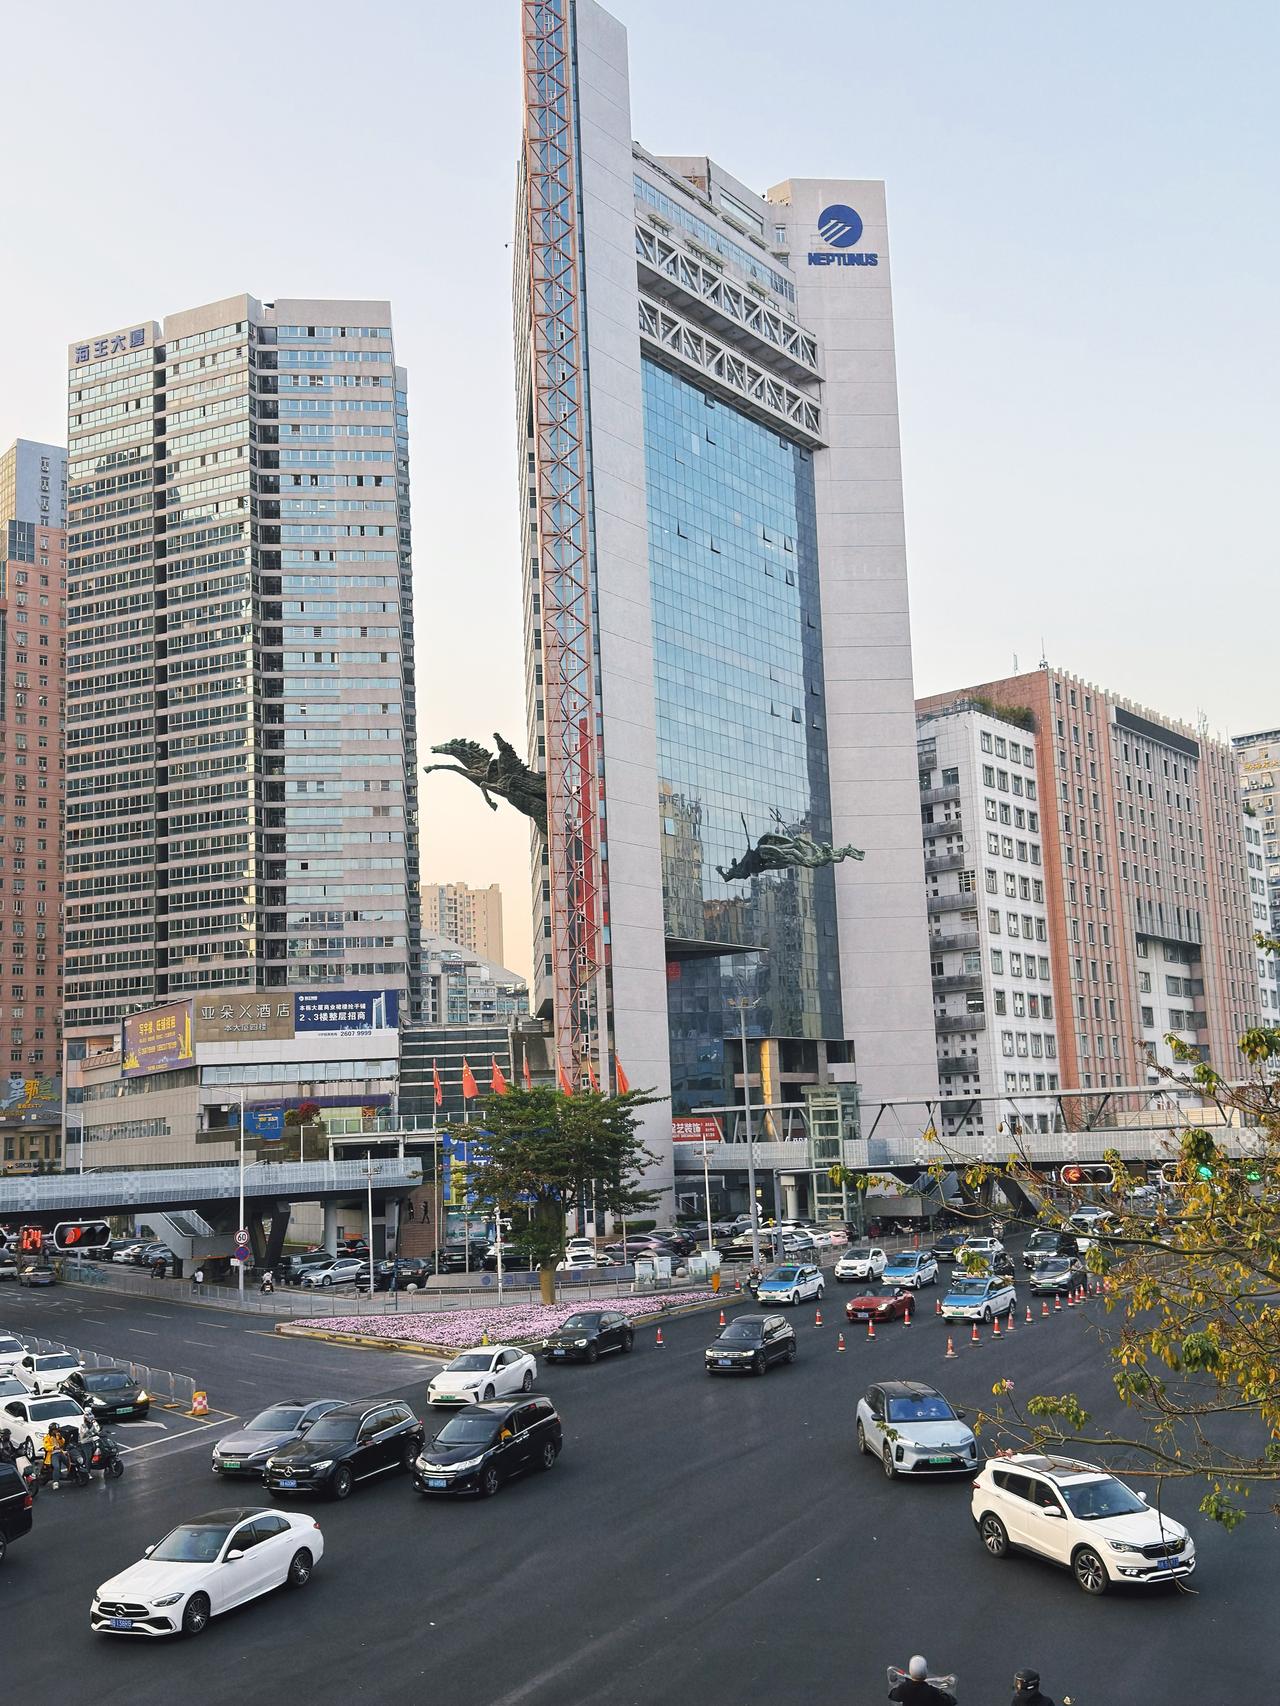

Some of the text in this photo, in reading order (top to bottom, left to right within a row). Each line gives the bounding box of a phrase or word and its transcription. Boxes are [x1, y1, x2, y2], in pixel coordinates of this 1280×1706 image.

[808, 253, 878, 266] NEPTUNUS
[75, 328, 145, 364] 海王大厦
[299, 1012, 366, 1022] 2、3楼整层招商
[237, 1233, 247, 1241] 60
